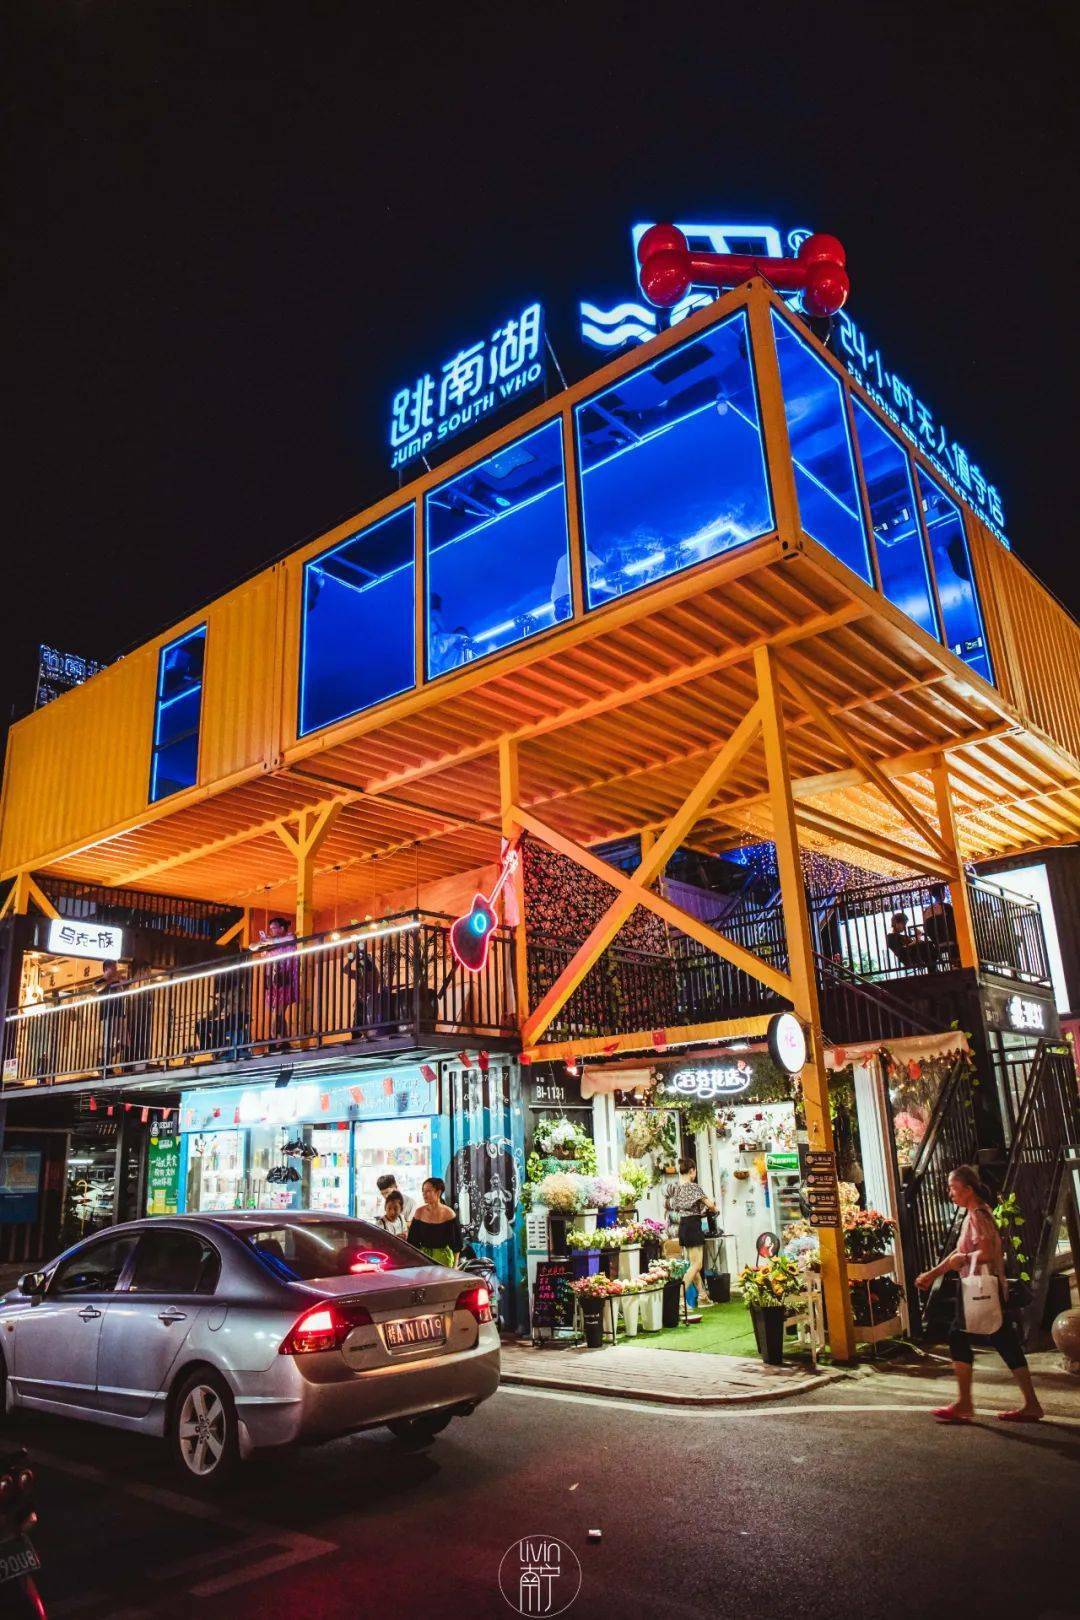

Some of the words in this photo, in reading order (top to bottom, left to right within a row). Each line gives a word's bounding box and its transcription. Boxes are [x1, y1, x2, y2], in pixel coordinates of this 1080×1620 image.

[391, 303, 541, 447] 跳南湖
[437, 391, 494, 440] SOUTH
[500, 362, 542, 398] WHO
